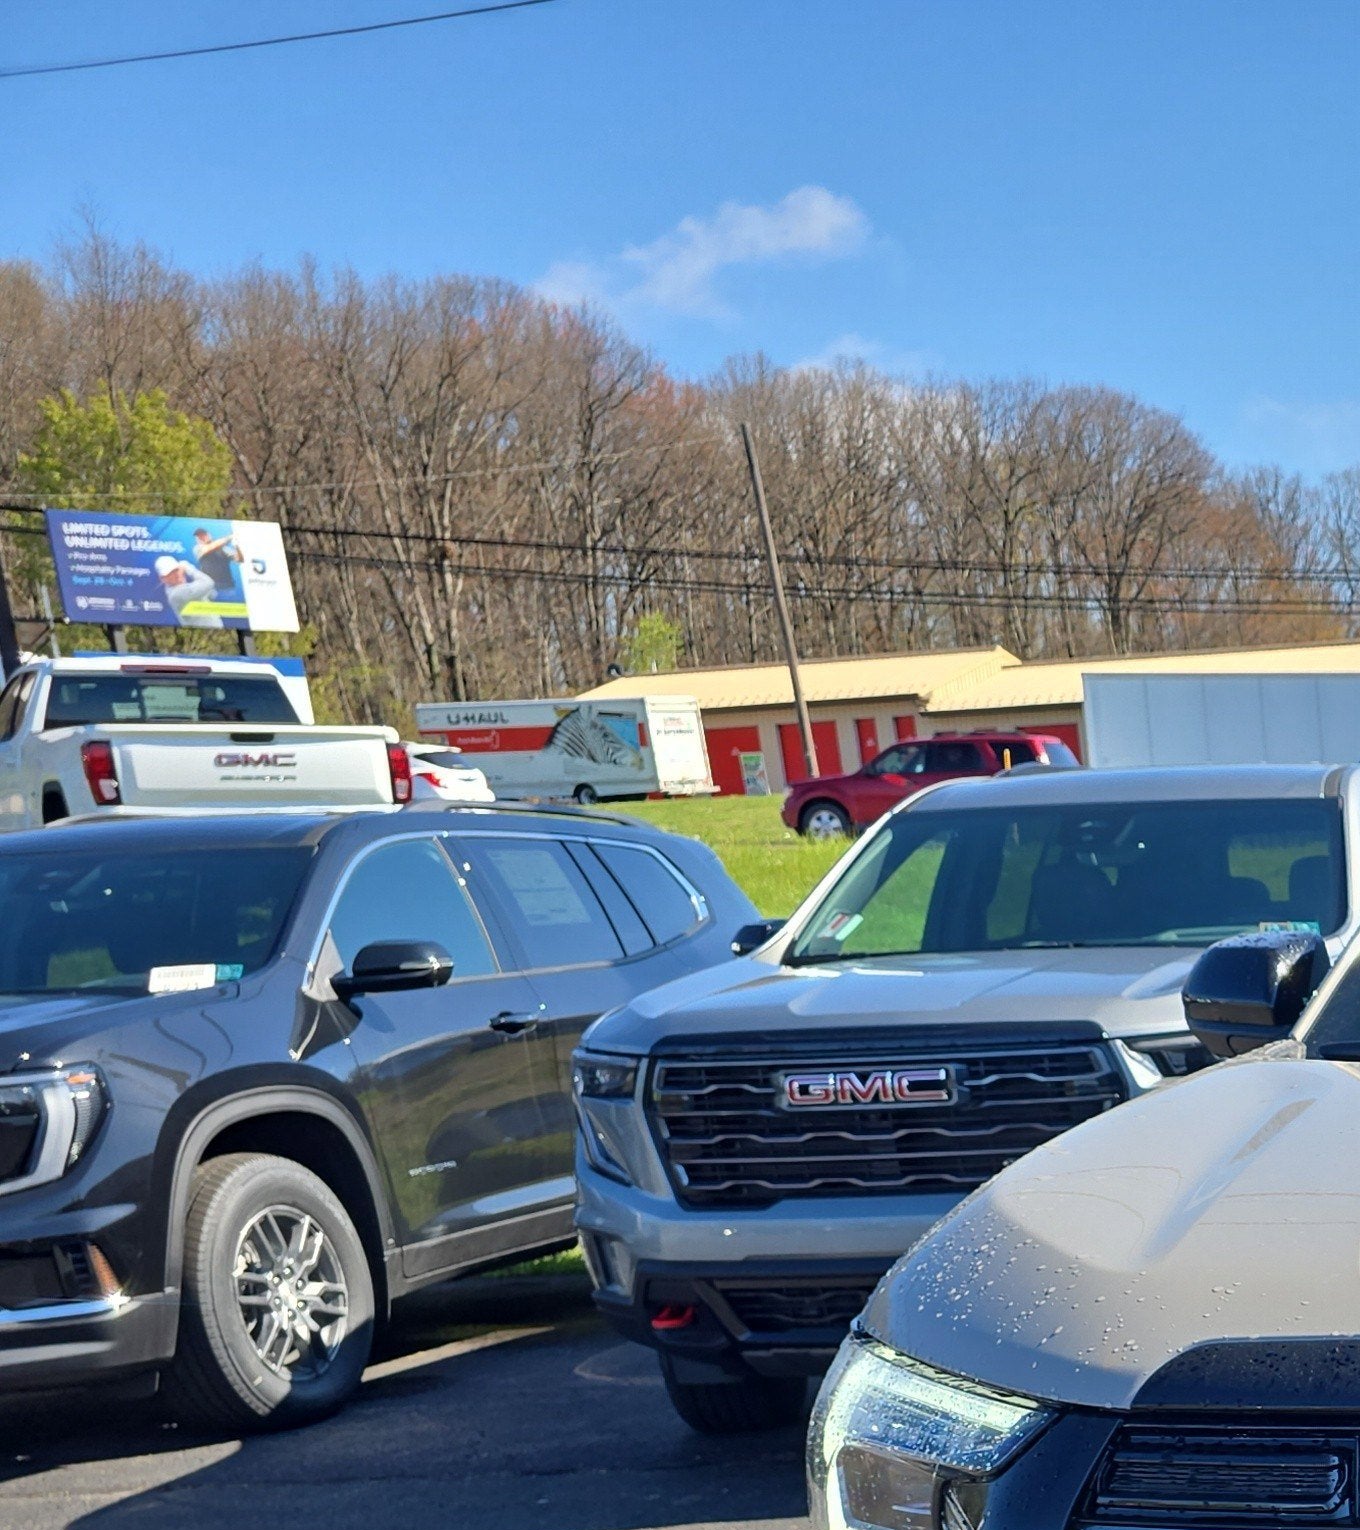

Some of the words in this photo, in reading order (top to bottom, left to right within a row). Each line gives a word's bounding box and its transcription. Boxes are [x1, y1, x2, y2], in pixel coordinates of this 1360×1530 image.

[62, 522, 111, 537] LIMITED
[64, 535, 130, 551] UNLIMITED
[213, 752, 298, 768] GMC
[783, 1067, 949, 1106] GMC
